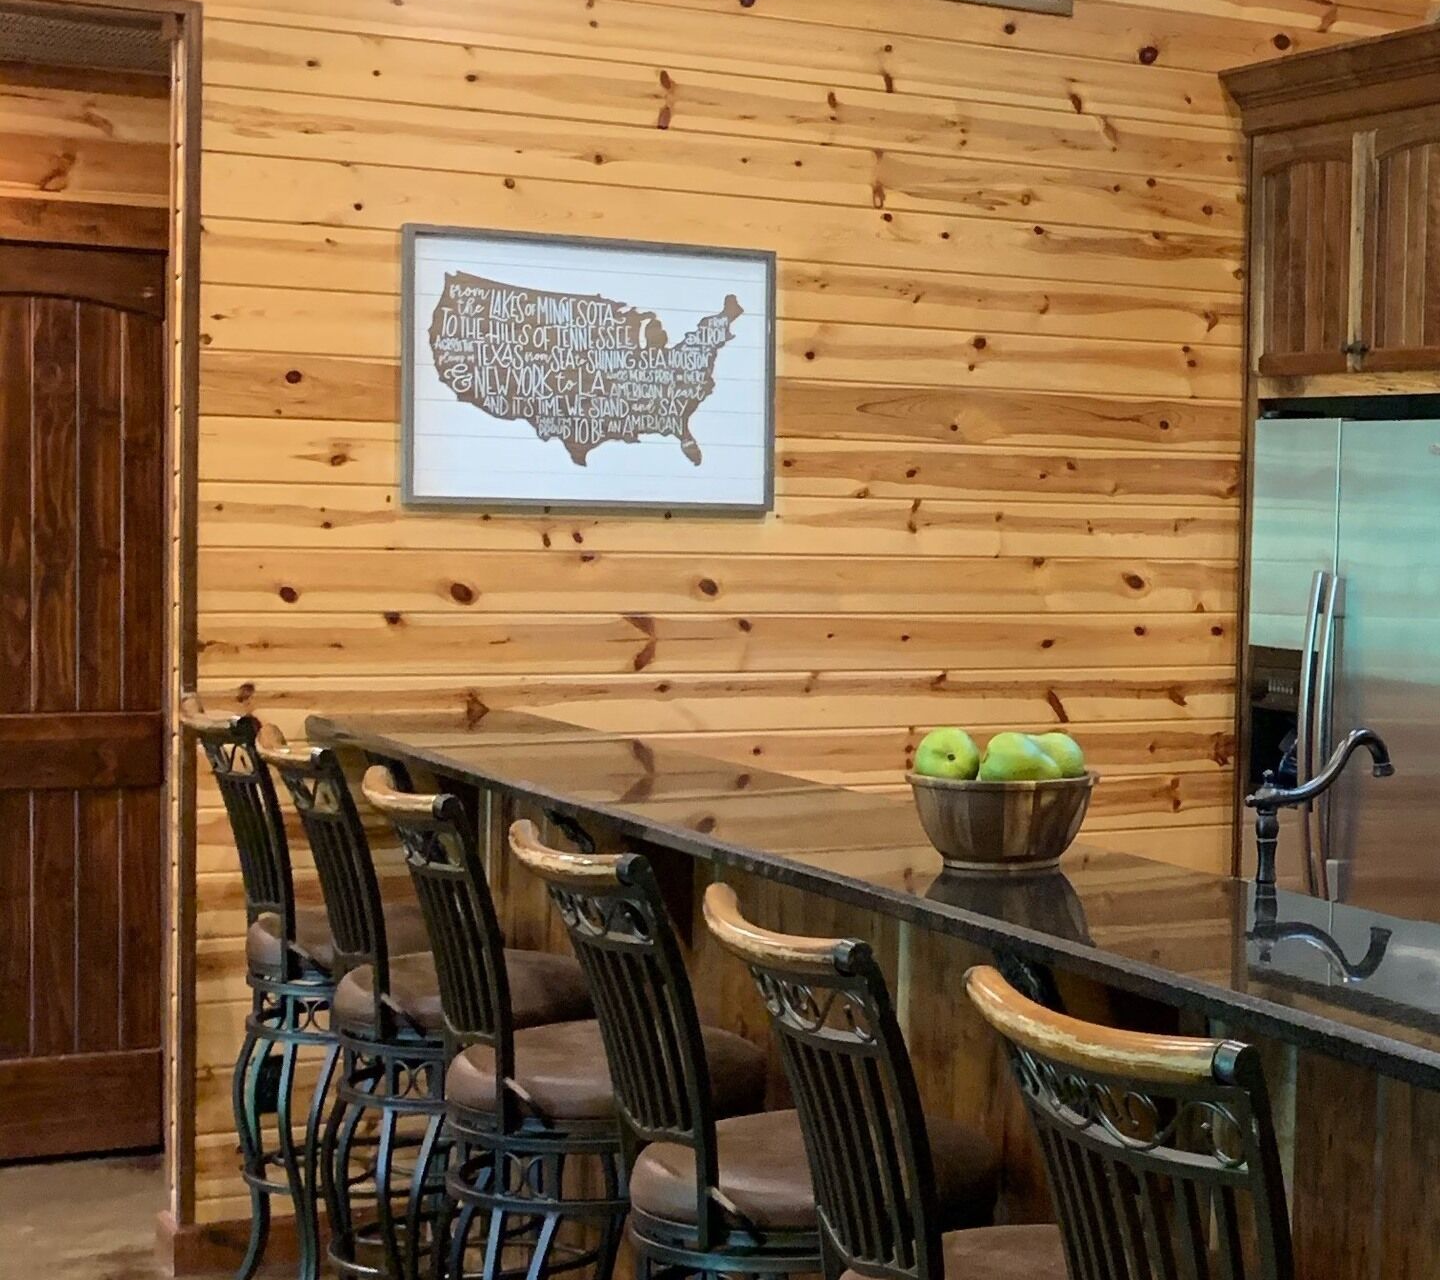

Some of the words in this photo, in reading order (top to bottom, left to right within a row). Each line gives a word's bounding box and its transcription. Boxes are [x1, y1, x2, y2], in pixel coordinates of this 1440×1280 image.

[458, 299, 484, 317] the
[490, 290, 528, 324] LAKES
[537, 296, 626, 329] MINNESOTA
[441, 307, 458, 337] TO
[459, 317, 485, 340] THE
[486, 321, 532, 346] HILLS
[533, 326, 553, 350] OF
[555, 324, 636, 351] TENNESSEE
[474, 340, 523, 370] TEXAS
[551, 347, 576, 372] SEA
[588, 350, 635, 374] SHINING
[638, 349, 665, 369] SEA
[669, 351, 712, 371] HOUSTON
[444, 364, 472, 392] &
[475, 366, 511, 397] NEW
[511, 368, 553, 399] YORK
[556, 372, 577, 393] to
[610, 384, 663, 401] AMERICAN
[668, 382, 704, 400] heart
[484, 397, 510, 415] AND
[512, 398, 534, 417] IT'S
[536, 398, 565, 416] TIME
[565, 397, 585, 416] WE
[589, 397, 628, 418] STAND
[632, 400, 656, 412] and
[659, 399, 689, 416] SAY
[574, 418, 590, 443] TO
[591, 417, 605, 444] BE
[608, 420, 622, 433] AN
[622, 415, 683, 437] AMERICAN
